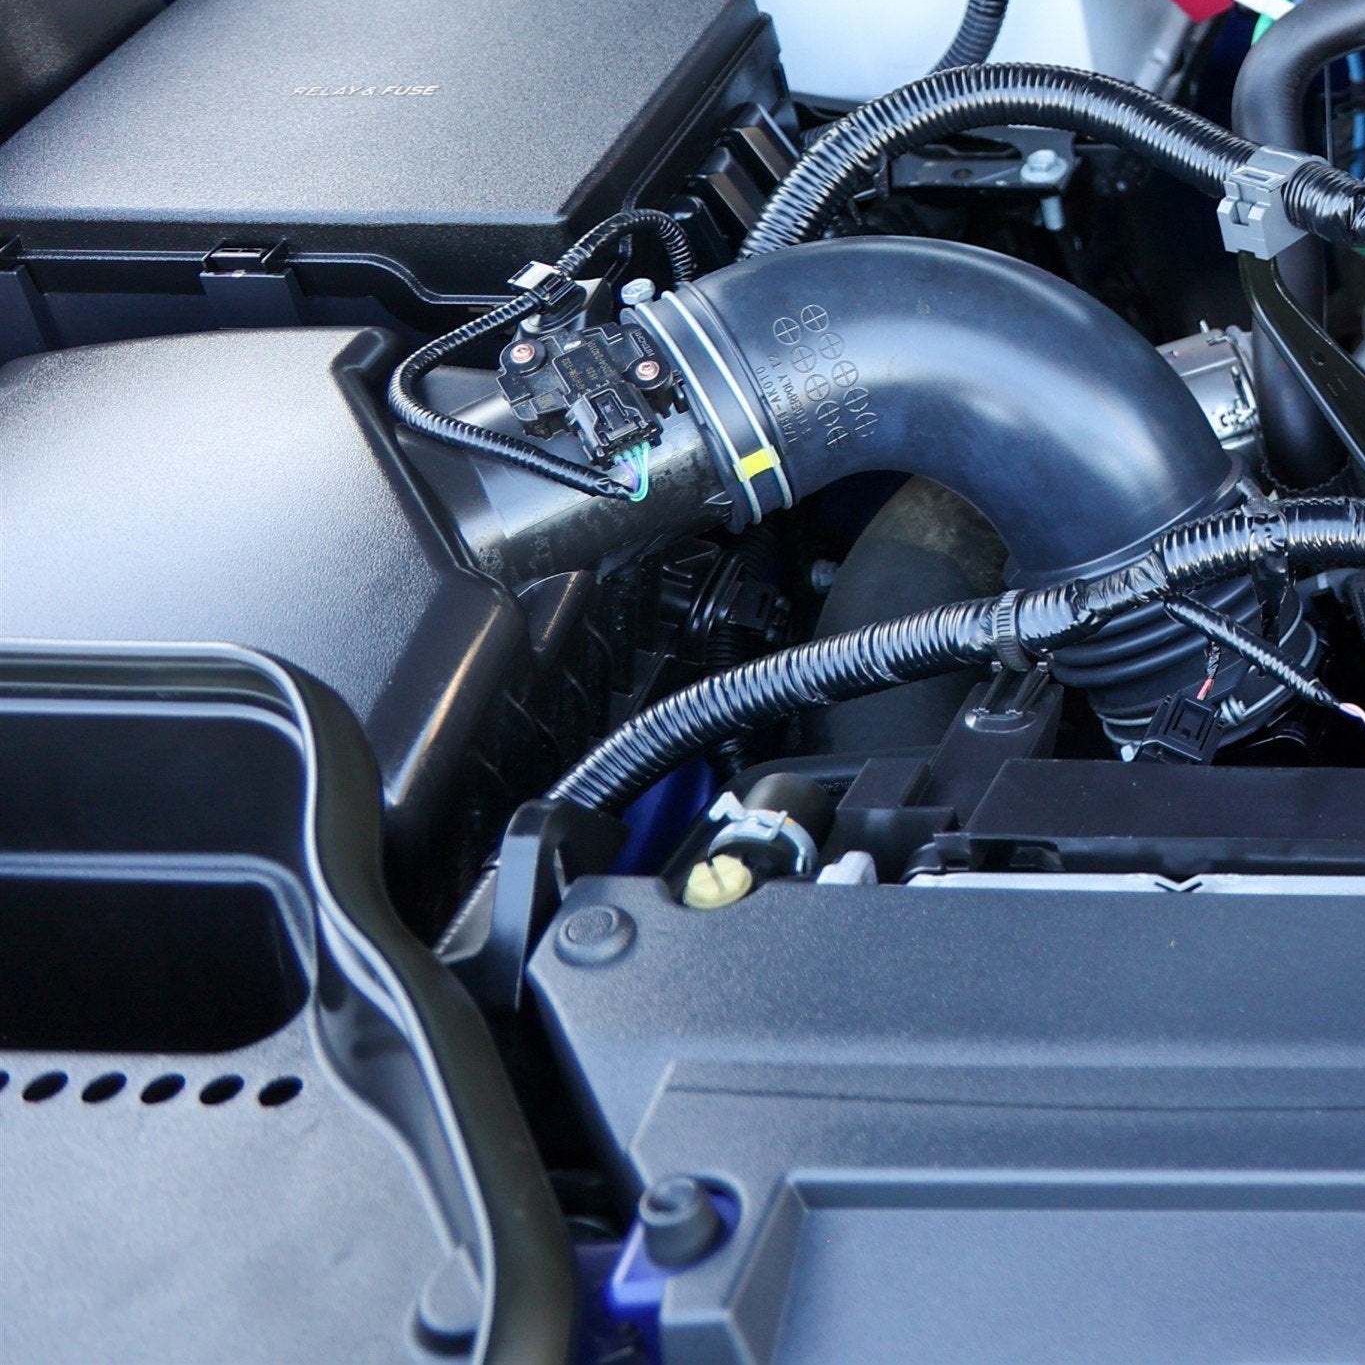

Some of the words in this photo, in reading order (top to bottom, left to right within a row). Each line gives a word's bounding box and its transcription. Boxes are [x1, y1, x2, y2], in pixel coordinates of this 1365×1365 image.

[291, 86, 358, 96] RELAY
[361, 86, 375, 96] &
[381, 85, 440, 96] FUSE
